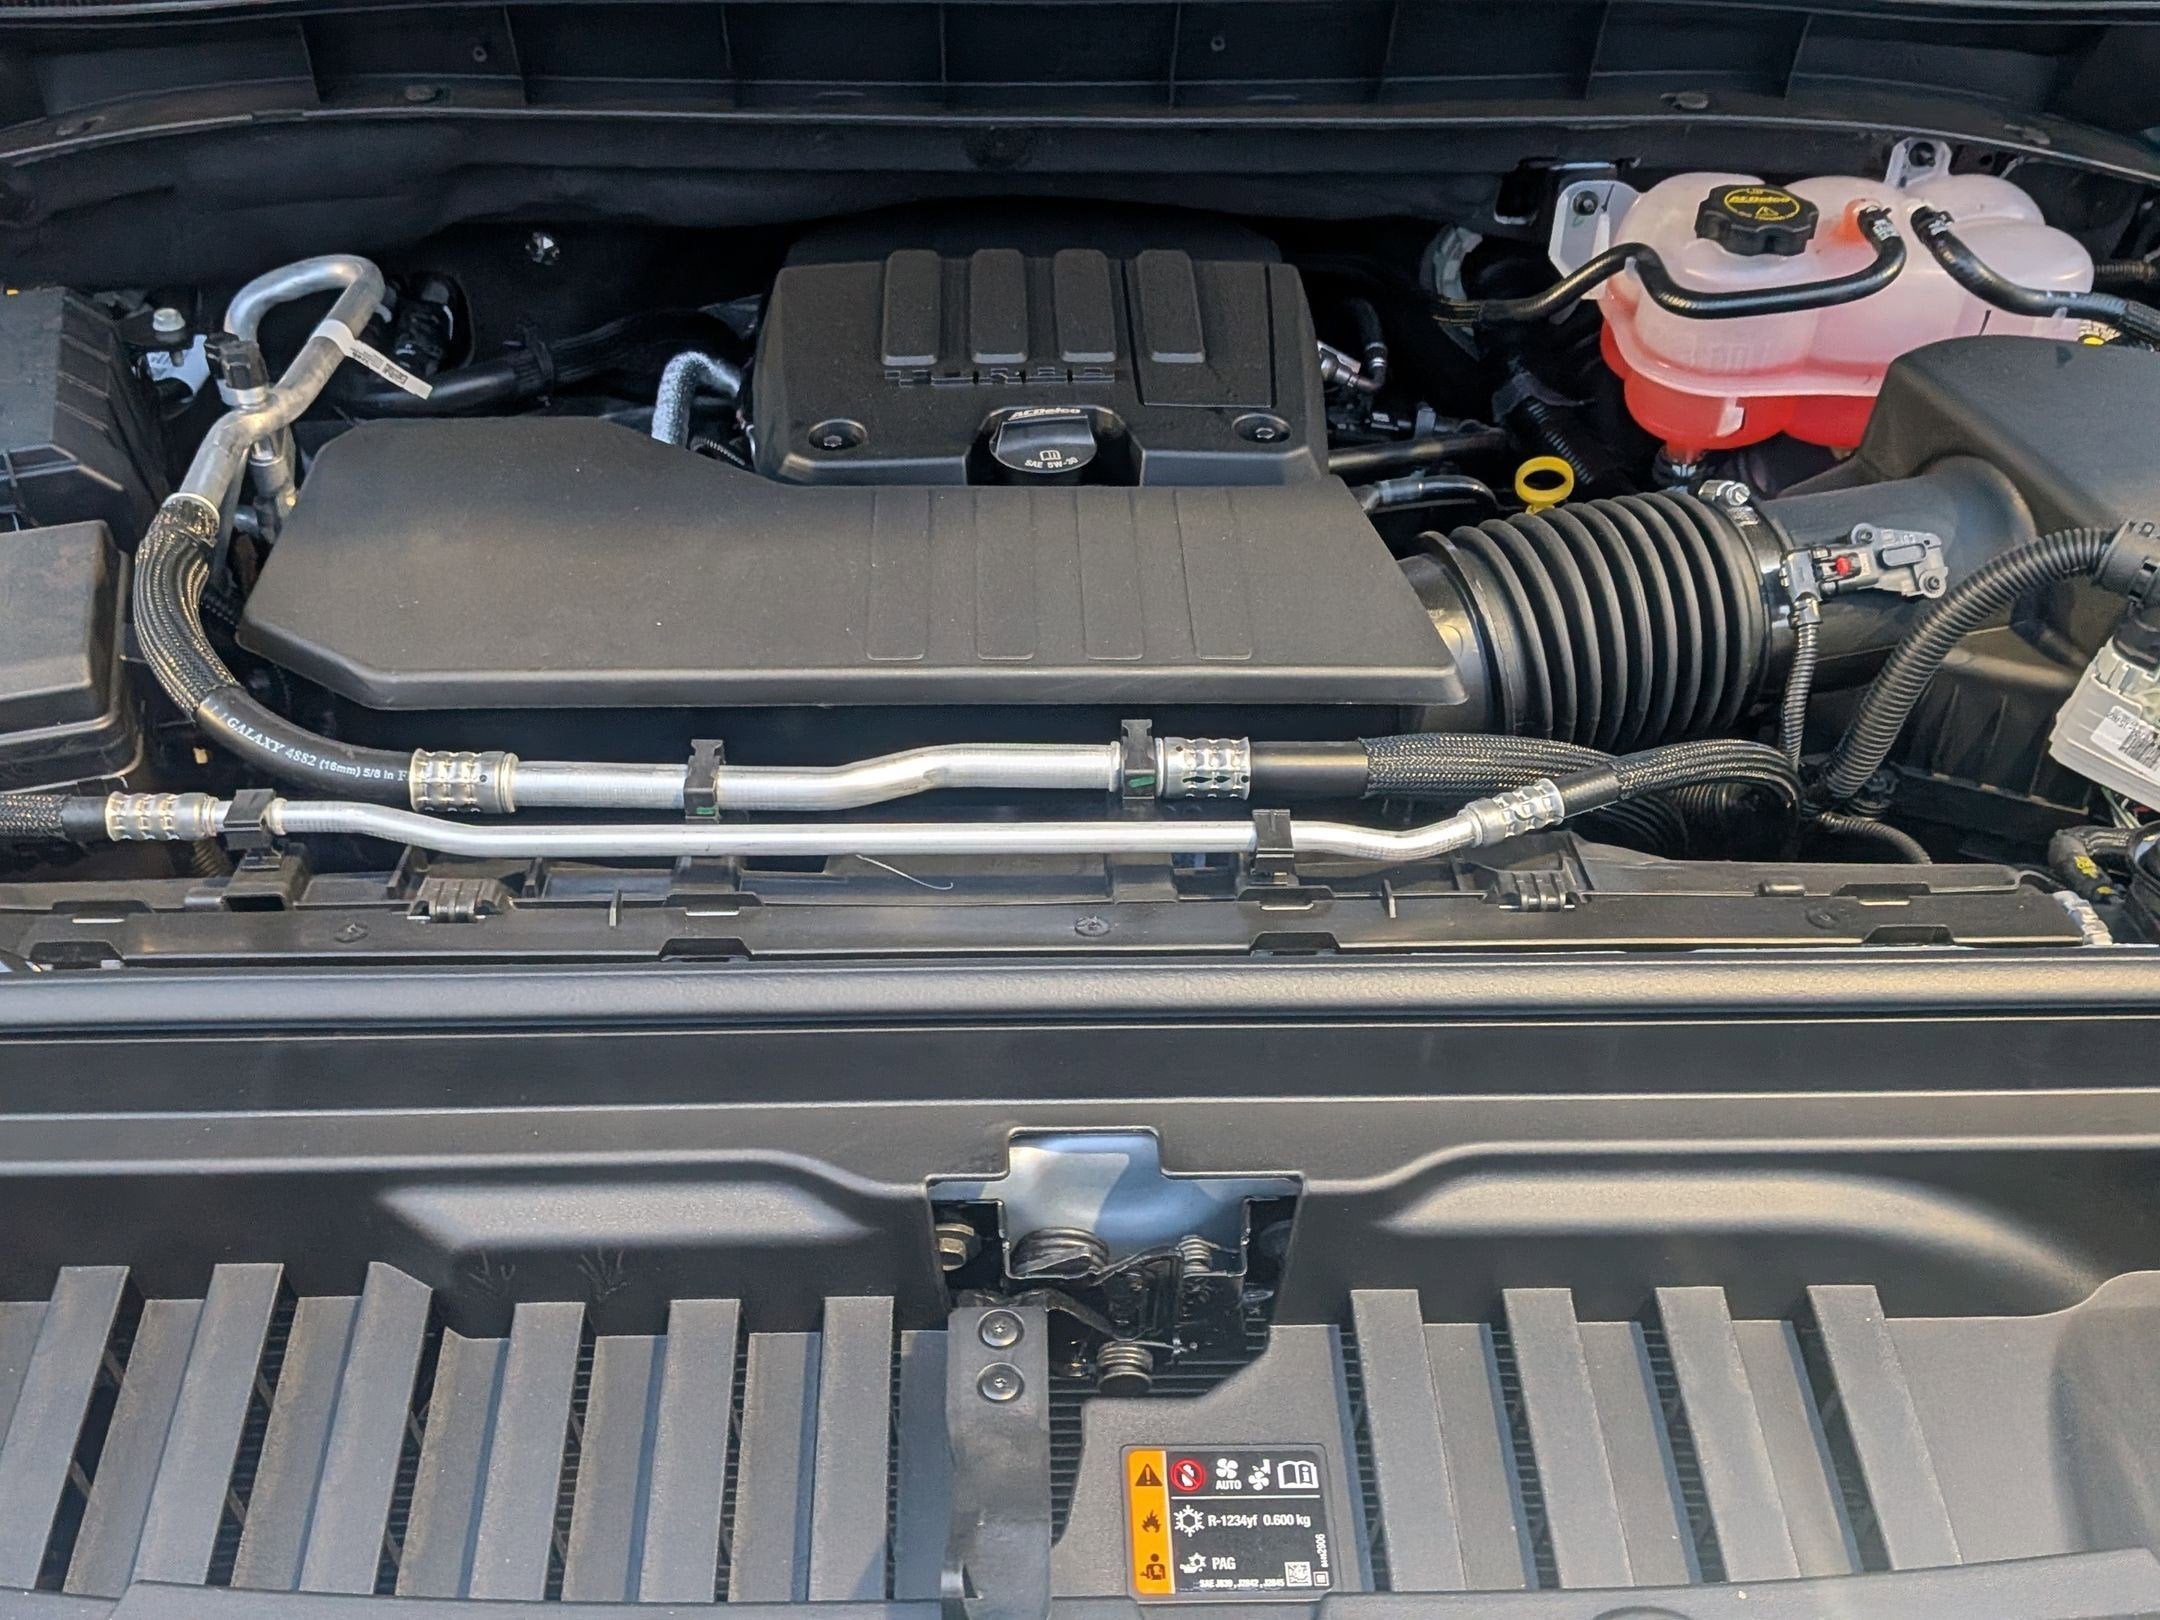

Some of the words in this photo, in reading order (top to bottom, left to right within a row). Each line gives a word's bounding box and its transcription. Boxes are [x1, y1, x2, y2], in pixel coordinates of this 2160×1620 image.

[1008, 408, 1081, 420] ACDelco
[1024, 459, 1043, 469] SAE
[227, 717, 286, 753] GALAXY
[319, 759, 361, 777] (16mm)
[362, 768, 381, 779] 5/8
[1215, 1479, 1242, 1490] AUTO
[1208, 1514, 1257, 1529] R-1234yf
[1263, 1514, 1294, 1526] 0.600
[1297, 1514, 1311, 1528] kg
[1212, 1557, 1236, 1570] PAG
